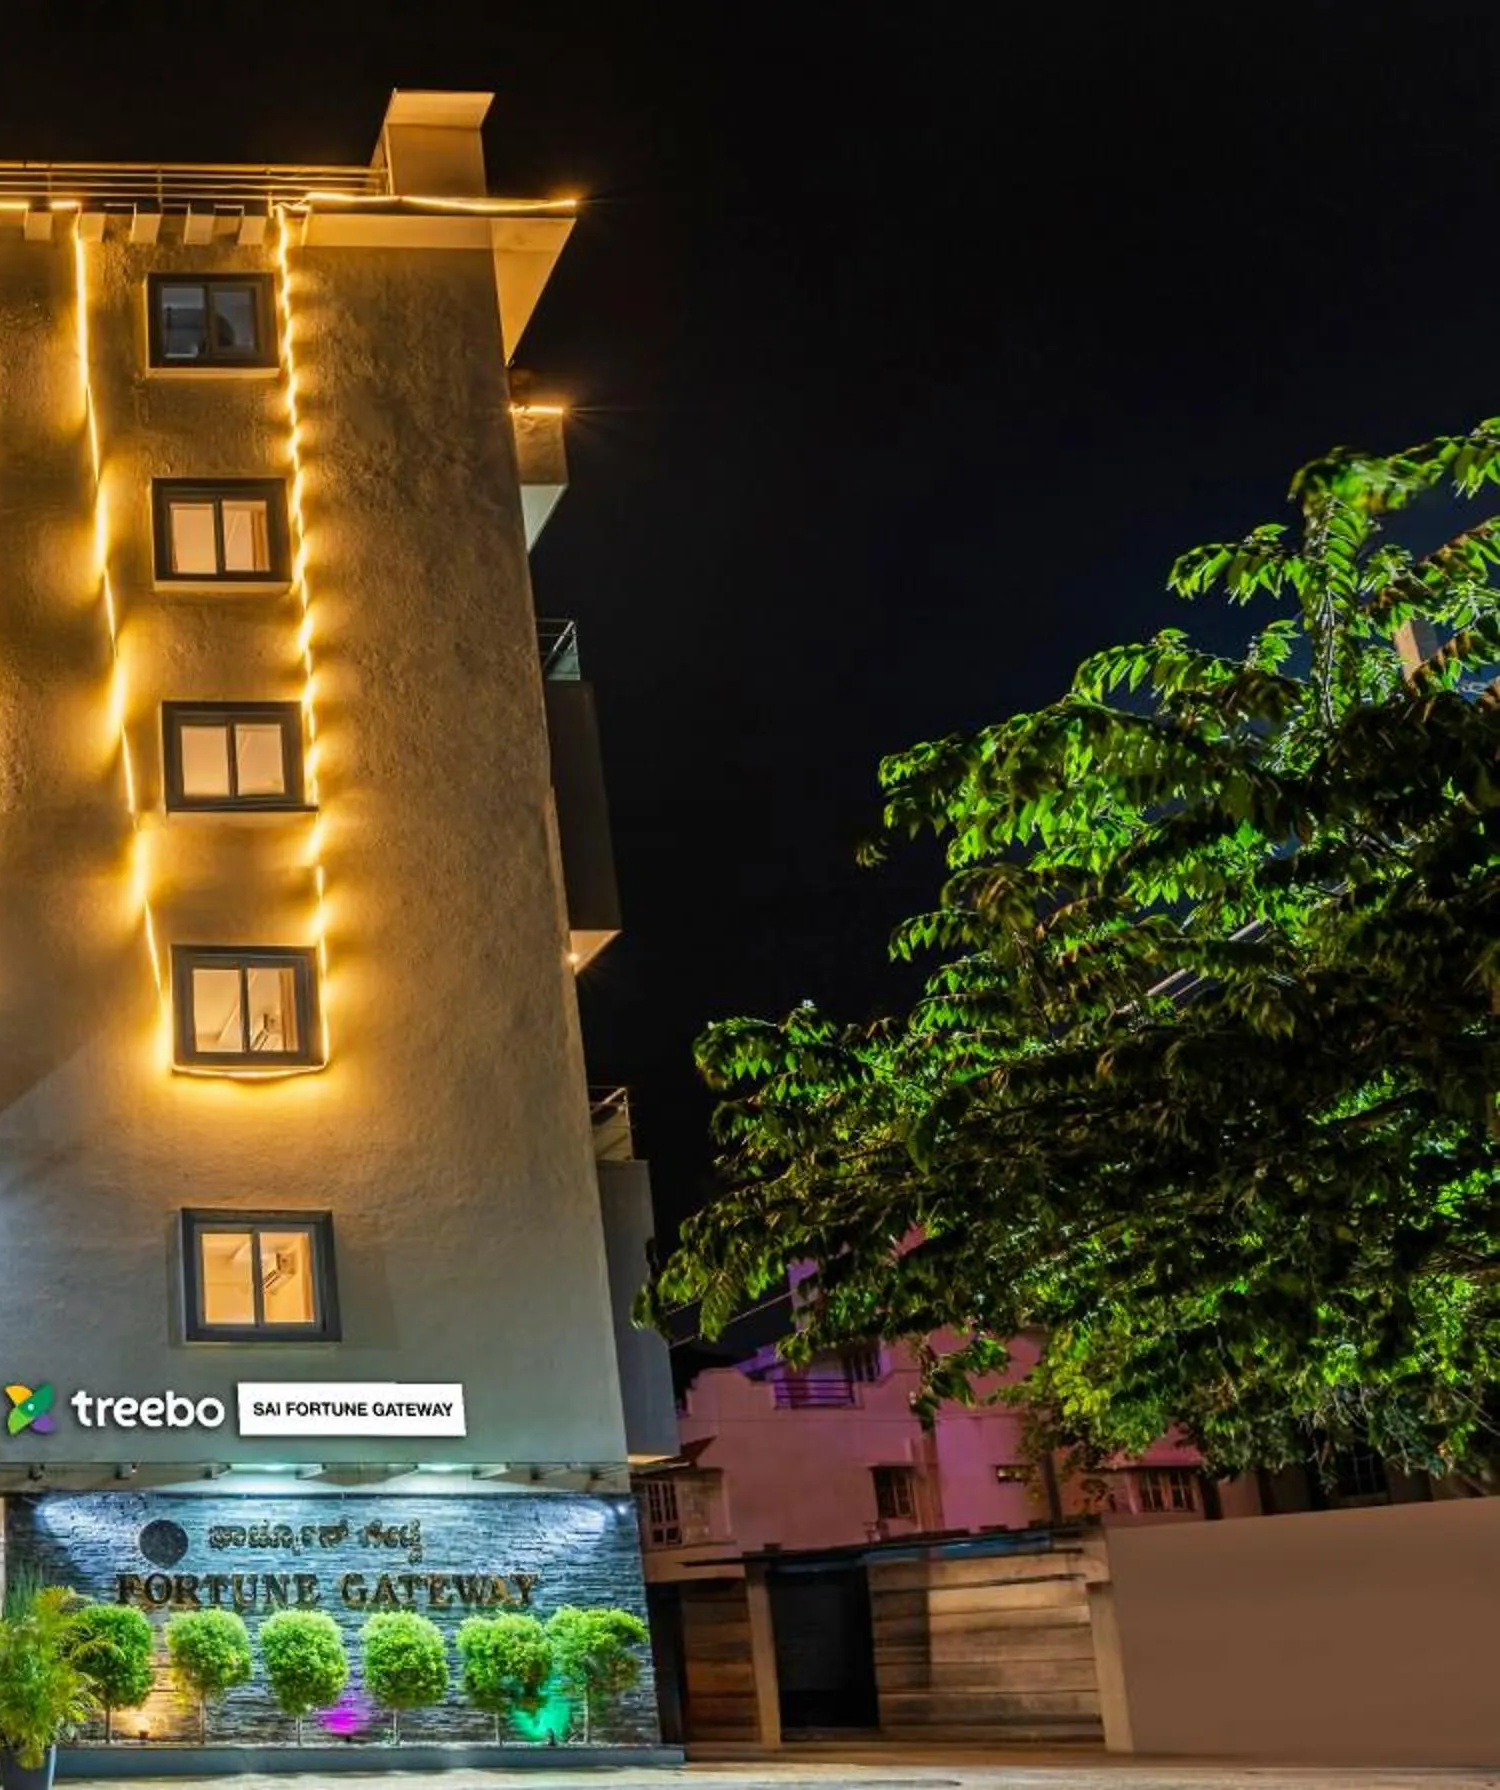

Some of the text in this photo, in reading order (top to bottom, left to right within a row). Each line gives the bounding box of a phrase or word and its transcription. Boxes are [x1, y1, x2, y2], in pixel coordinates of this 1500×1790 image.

[71, 1390, 225, 1427] treebo
[252, 1401, 454, 1417] SAI FORTUNE GATEWAY
[115, 1573, 541, 1605] FORTUNE GATEWAY
